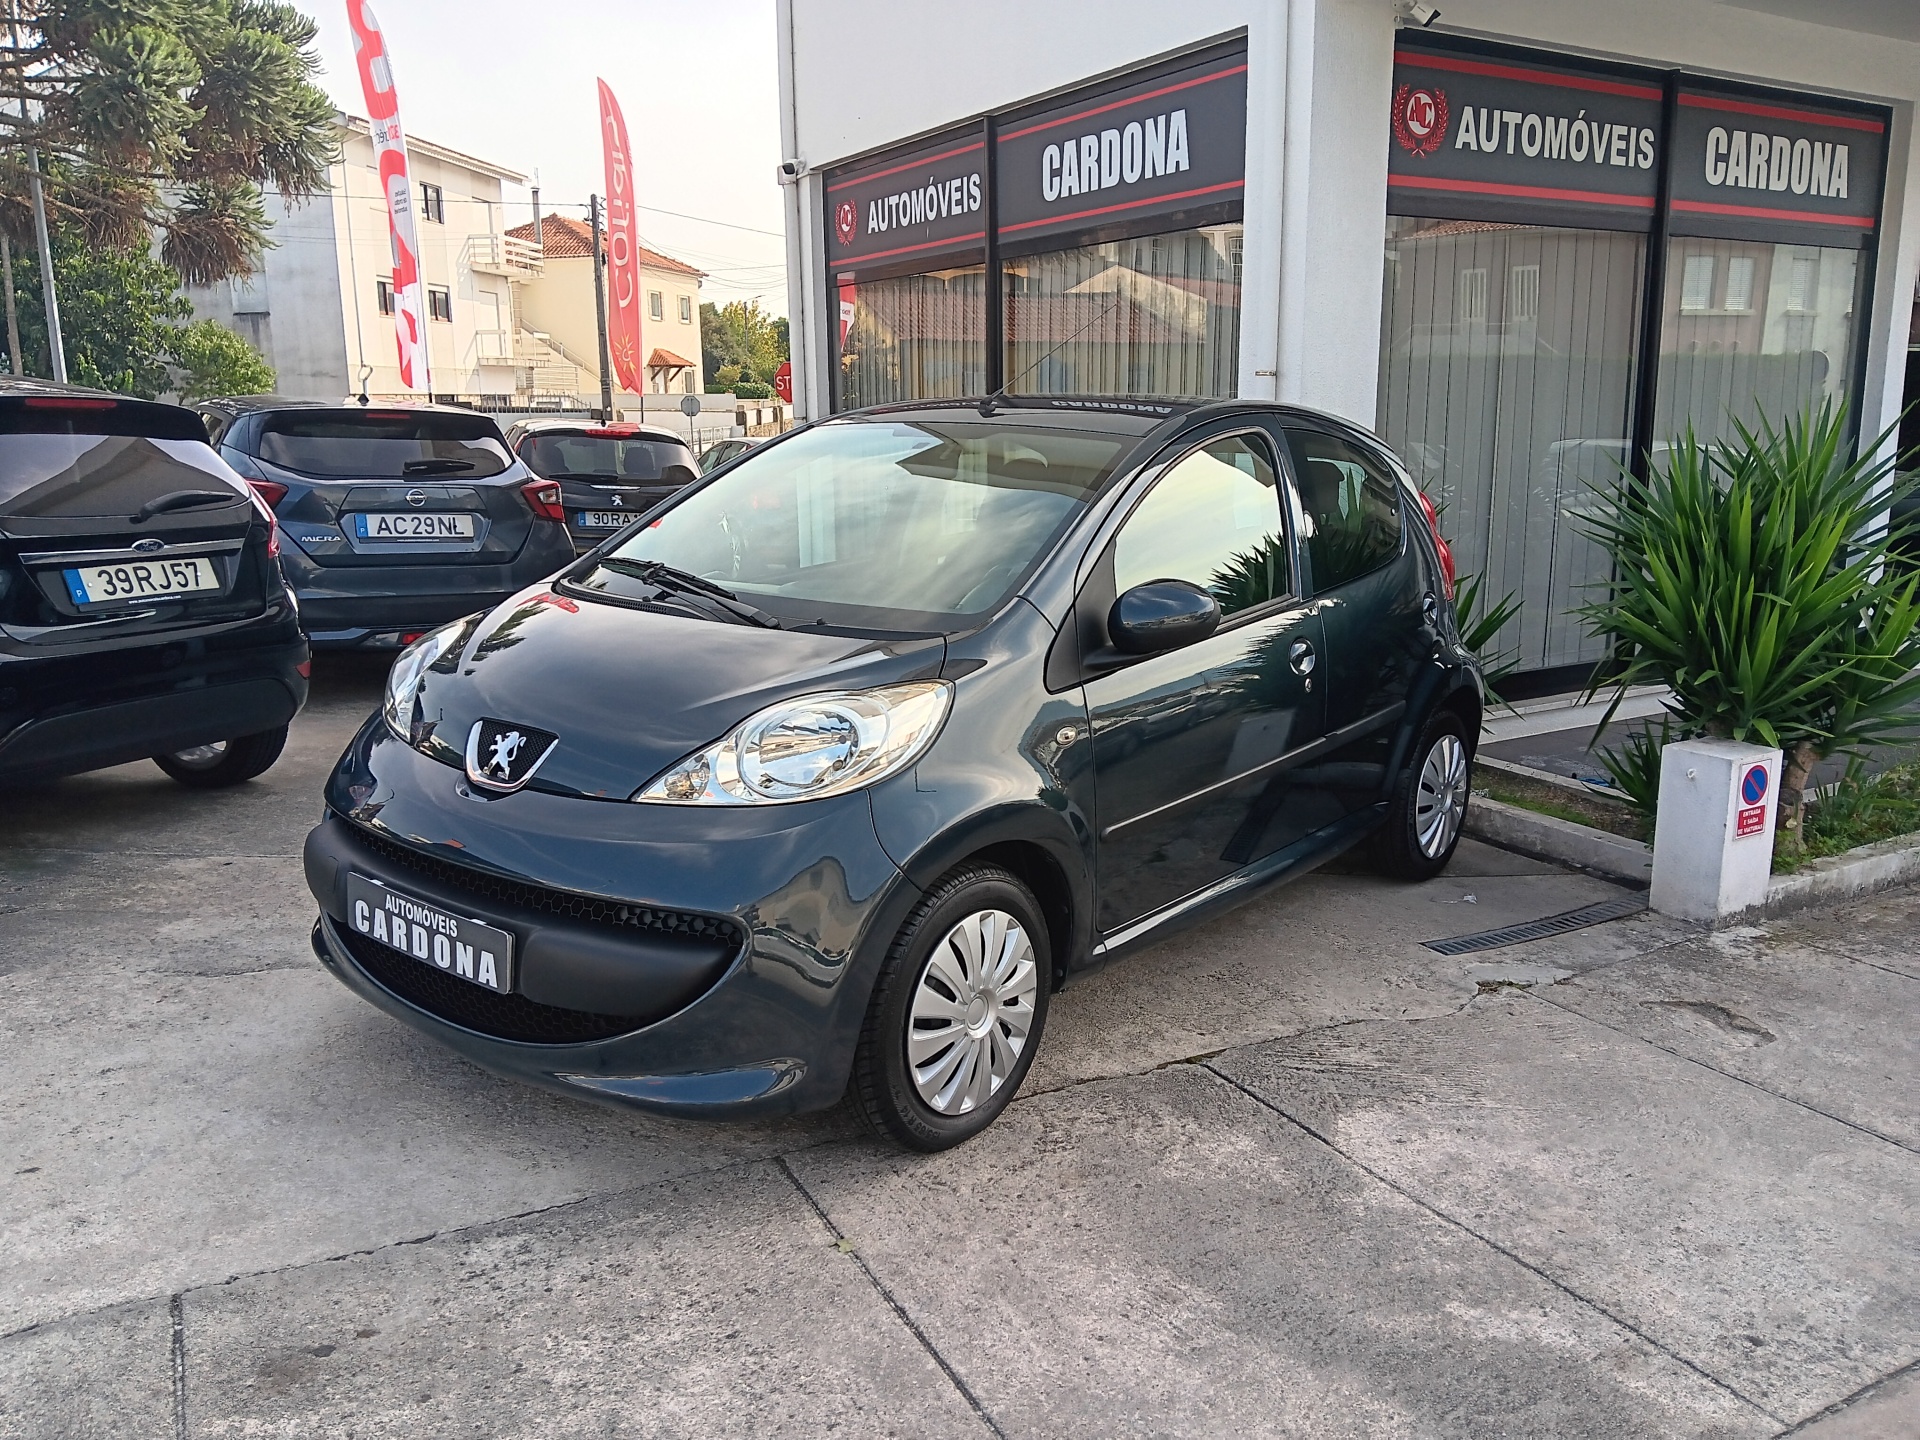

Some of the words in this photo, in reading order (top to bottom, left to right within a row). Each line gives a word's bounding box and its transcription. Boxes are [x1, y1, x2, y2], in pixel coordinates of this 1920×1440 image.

[867, 173, 982, 235] AUTOMÓVEIS
[1042, 108, 1190, 203] CARDONA
[1455, 105, 1656, 170] AUTOMÓVEIS
[1705, 126, 1849, 199] CARDONA
[776, 375, 791, 391] ST
[377, 516, 465, 535] AC29NL
[593, 513, 642, 526] 90RA
[97, 562, 200, 597] 39RJ57
[385, 893, 458, 938] AUTOMÓVEIS
[355, 899, 498, 989] CARDONA
